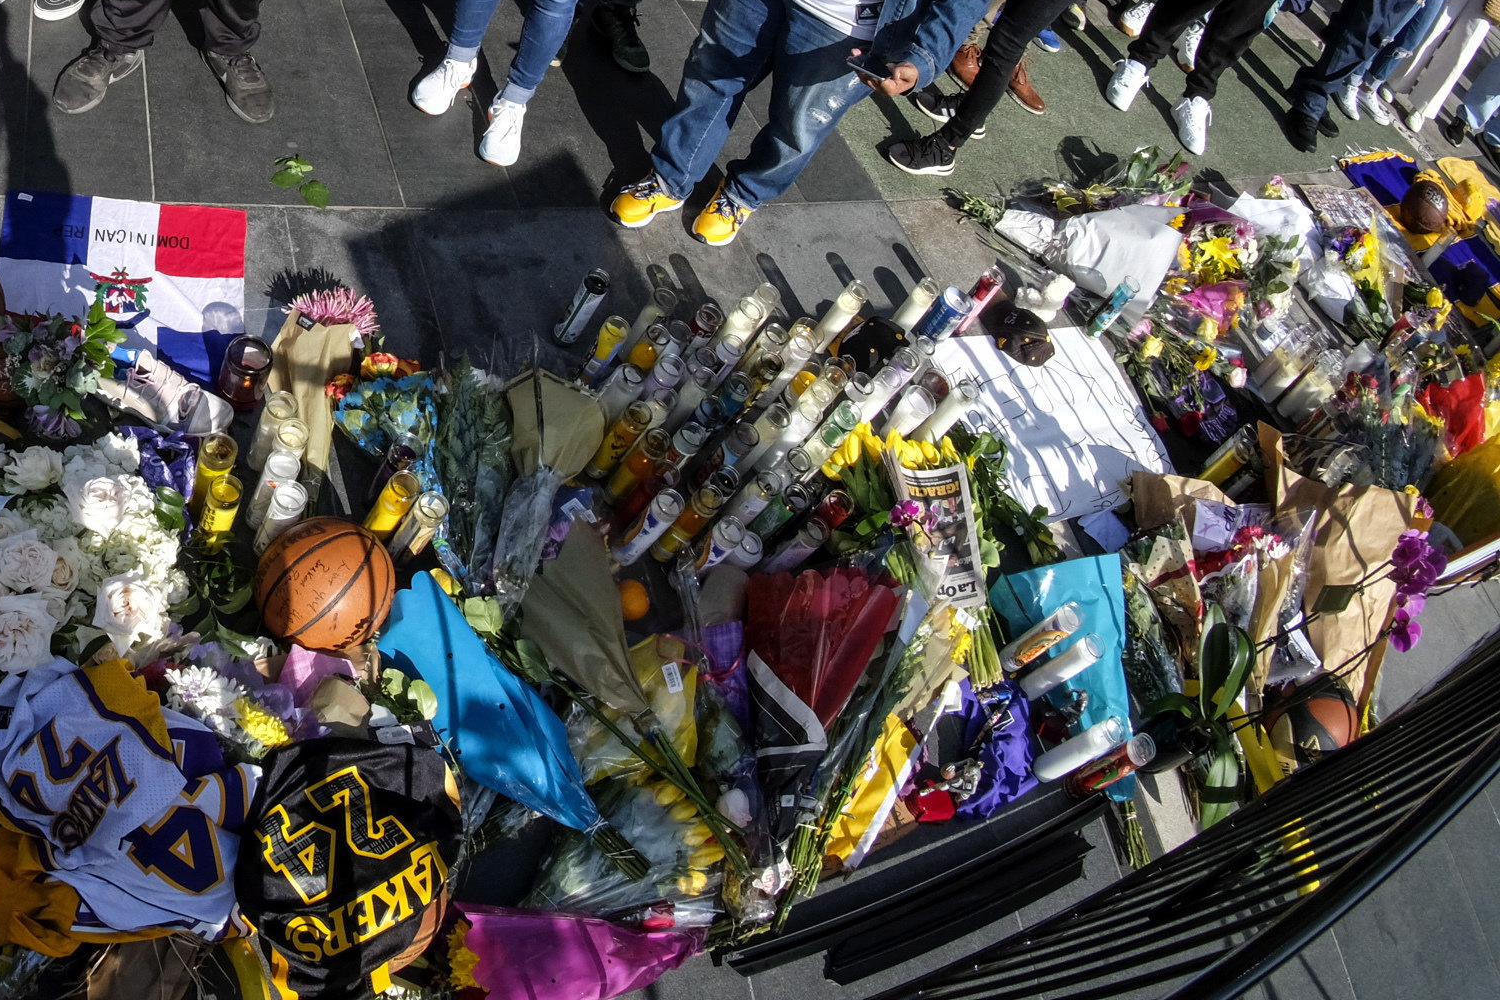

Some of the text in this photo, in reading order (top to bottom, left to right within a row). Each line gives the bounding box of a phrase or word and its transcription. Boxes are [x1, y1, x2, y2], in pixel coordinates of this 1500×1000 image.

[53, 223, 190, 250] DOMINICAN REP
[958, 580, 977, 595] La
[255, 766, 415, 906] 24
[285, 840, 449, 961] LAKERS
